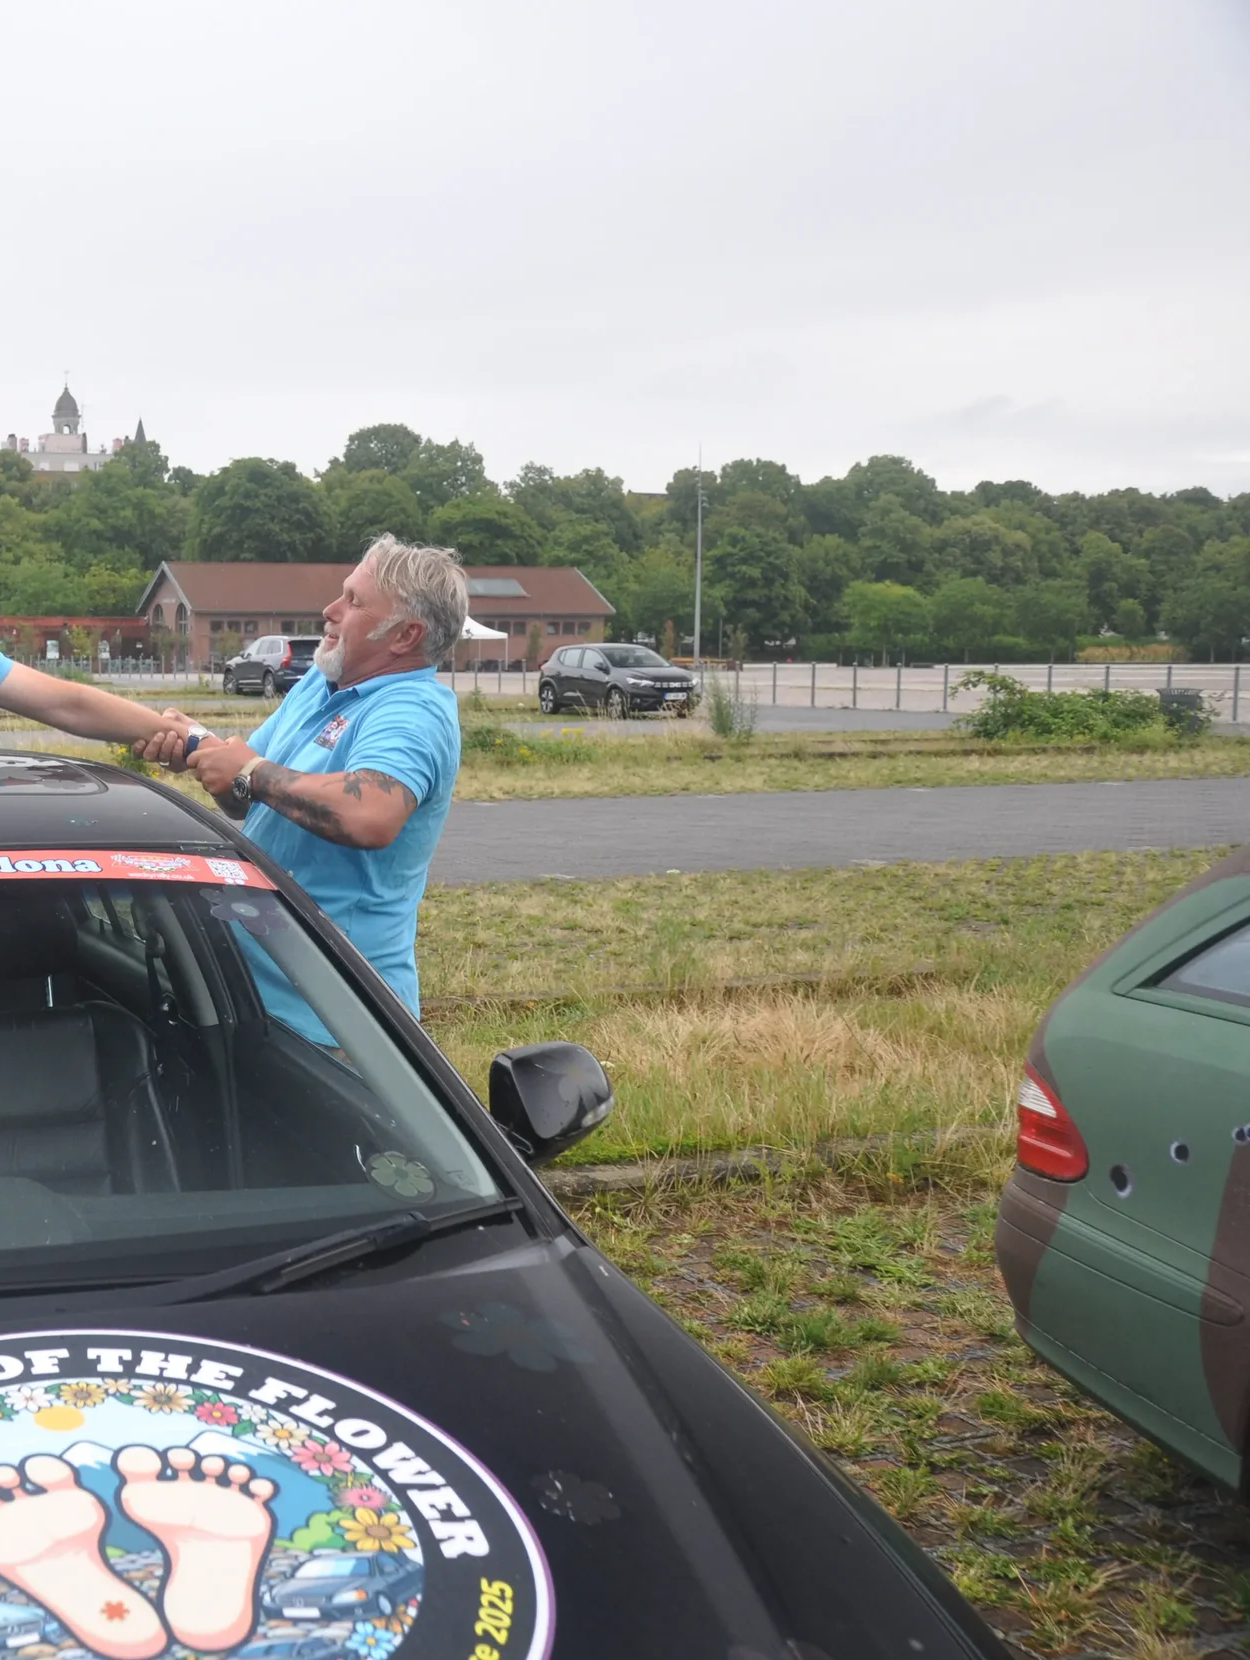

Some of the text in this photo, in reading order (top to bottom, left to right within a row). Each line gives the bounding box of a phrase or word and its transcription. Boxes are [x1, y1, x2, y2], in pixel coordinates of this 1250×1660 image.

[87, 1348, 243, 1390] THE
[248, 1376, 491, 1559] FLOWER
[474, 1577, 514, 1646] 2025
